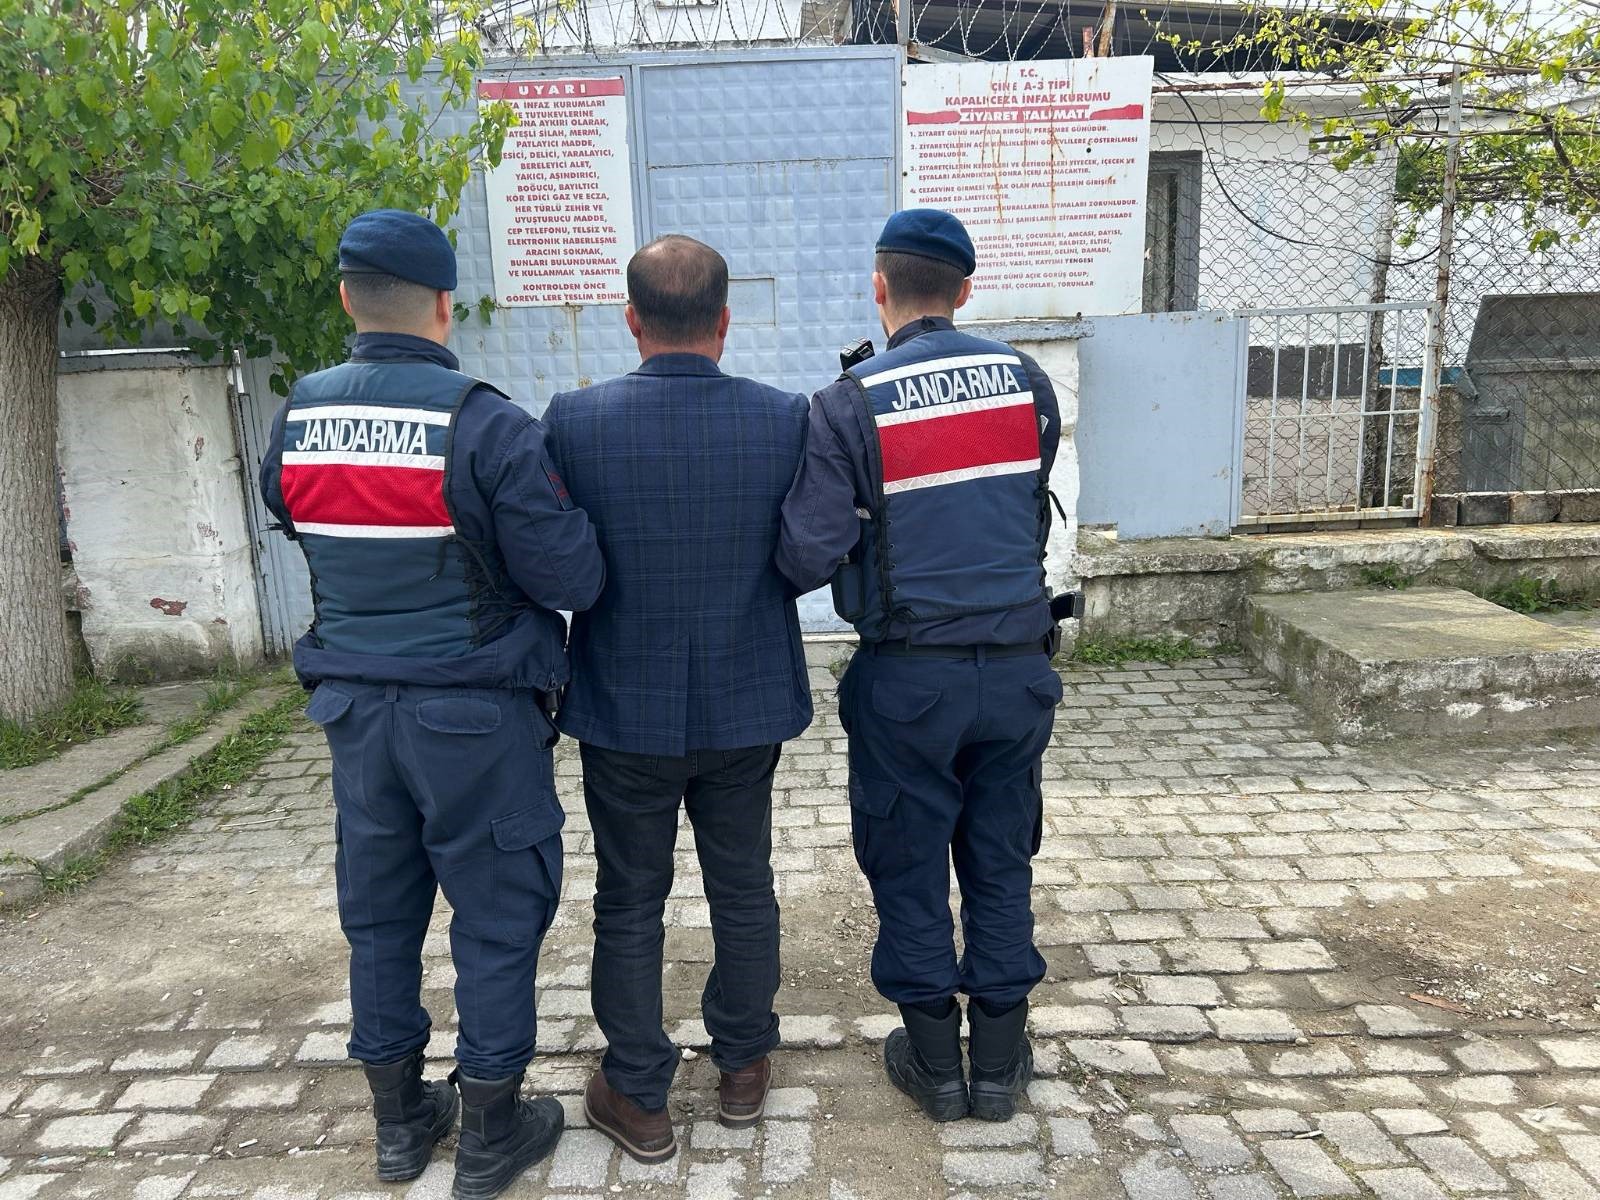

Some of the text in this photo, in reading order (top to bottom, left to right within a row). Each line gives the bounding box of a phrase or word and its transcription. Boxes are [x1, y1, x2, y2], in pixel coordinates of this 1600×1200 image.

[1020, 69, 1038, 78] T.C.
[518, 84, 586, 96] UYARI
[1024, 82, 1043, 90] A-3
[991, 95, 1017, 105] CEZA
[1060, 92, 1110, 103] KURUMU
[554, 100, 605, 108] KURUMLARI
[960, 107, 1019, 122] ZİYARET
[503, 151, 527, 160] ESİCİ,
[562, 149, 614, 157] YARALAYICI,
[516, 173, 547, 181] YAKICI,
[518, 183, 599, 192] BOĞUCU, BAYILTICI
[534, 203, 561, 212] TÜRLÜ
[565, 203, 590, 211] ZEHİR
[515, 215, 571, 225] UYUŞTURUCU
[573, 225, 599, 233] TELSİZ
[563, 237, 617, 245] HABERLEŞME
[563, 248, 603, 256] SOKMAK,
[892, 365, 1021, 410] JANDARMA
[296, 419, 427, 454] JANDARMA
